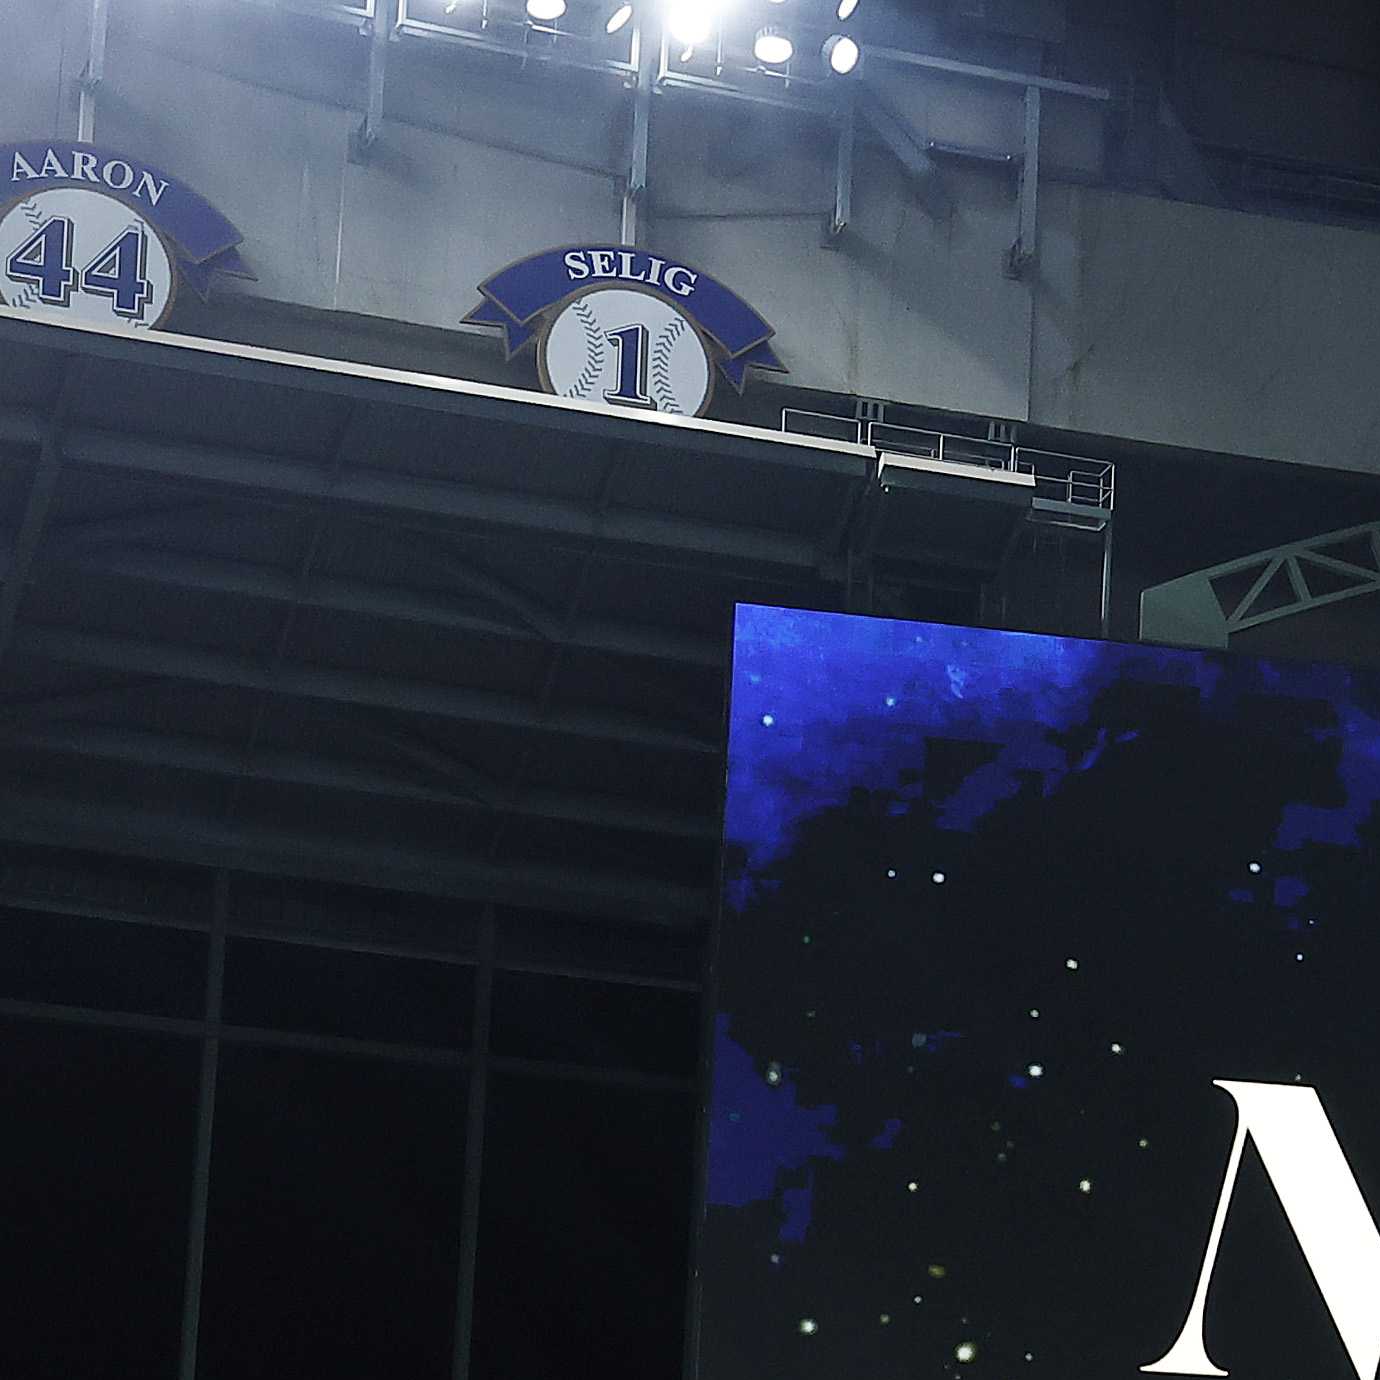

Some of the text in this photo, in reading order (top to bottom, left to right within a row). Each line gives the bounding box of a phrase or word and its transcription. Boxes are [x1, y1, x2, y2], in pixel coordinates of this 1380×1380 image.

[11, 149, 169, 206] AARON
[5, 216, 154, 320] 44
[564, 250, 700, 297] SELIG
[603, 323, 657, 411] 1
